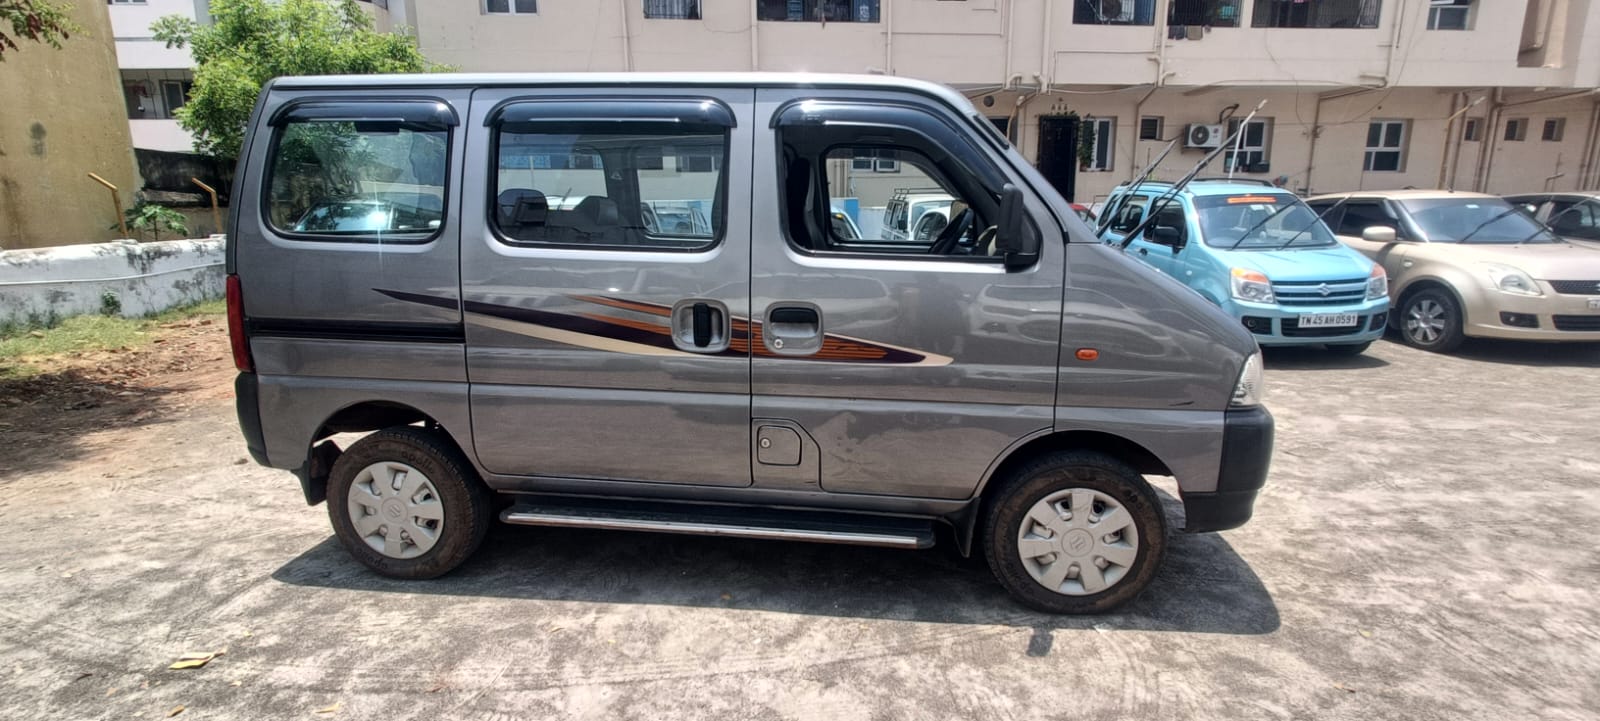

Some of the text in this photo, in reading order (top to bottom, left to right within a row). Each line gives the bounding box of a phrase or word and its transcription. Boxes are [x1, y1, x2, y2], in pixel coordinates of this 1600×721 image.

[1301, 316, 1312, 325] TN
[1324, 315, 1335, 324] AH
[1336, 315, 1356, 324] 0591
